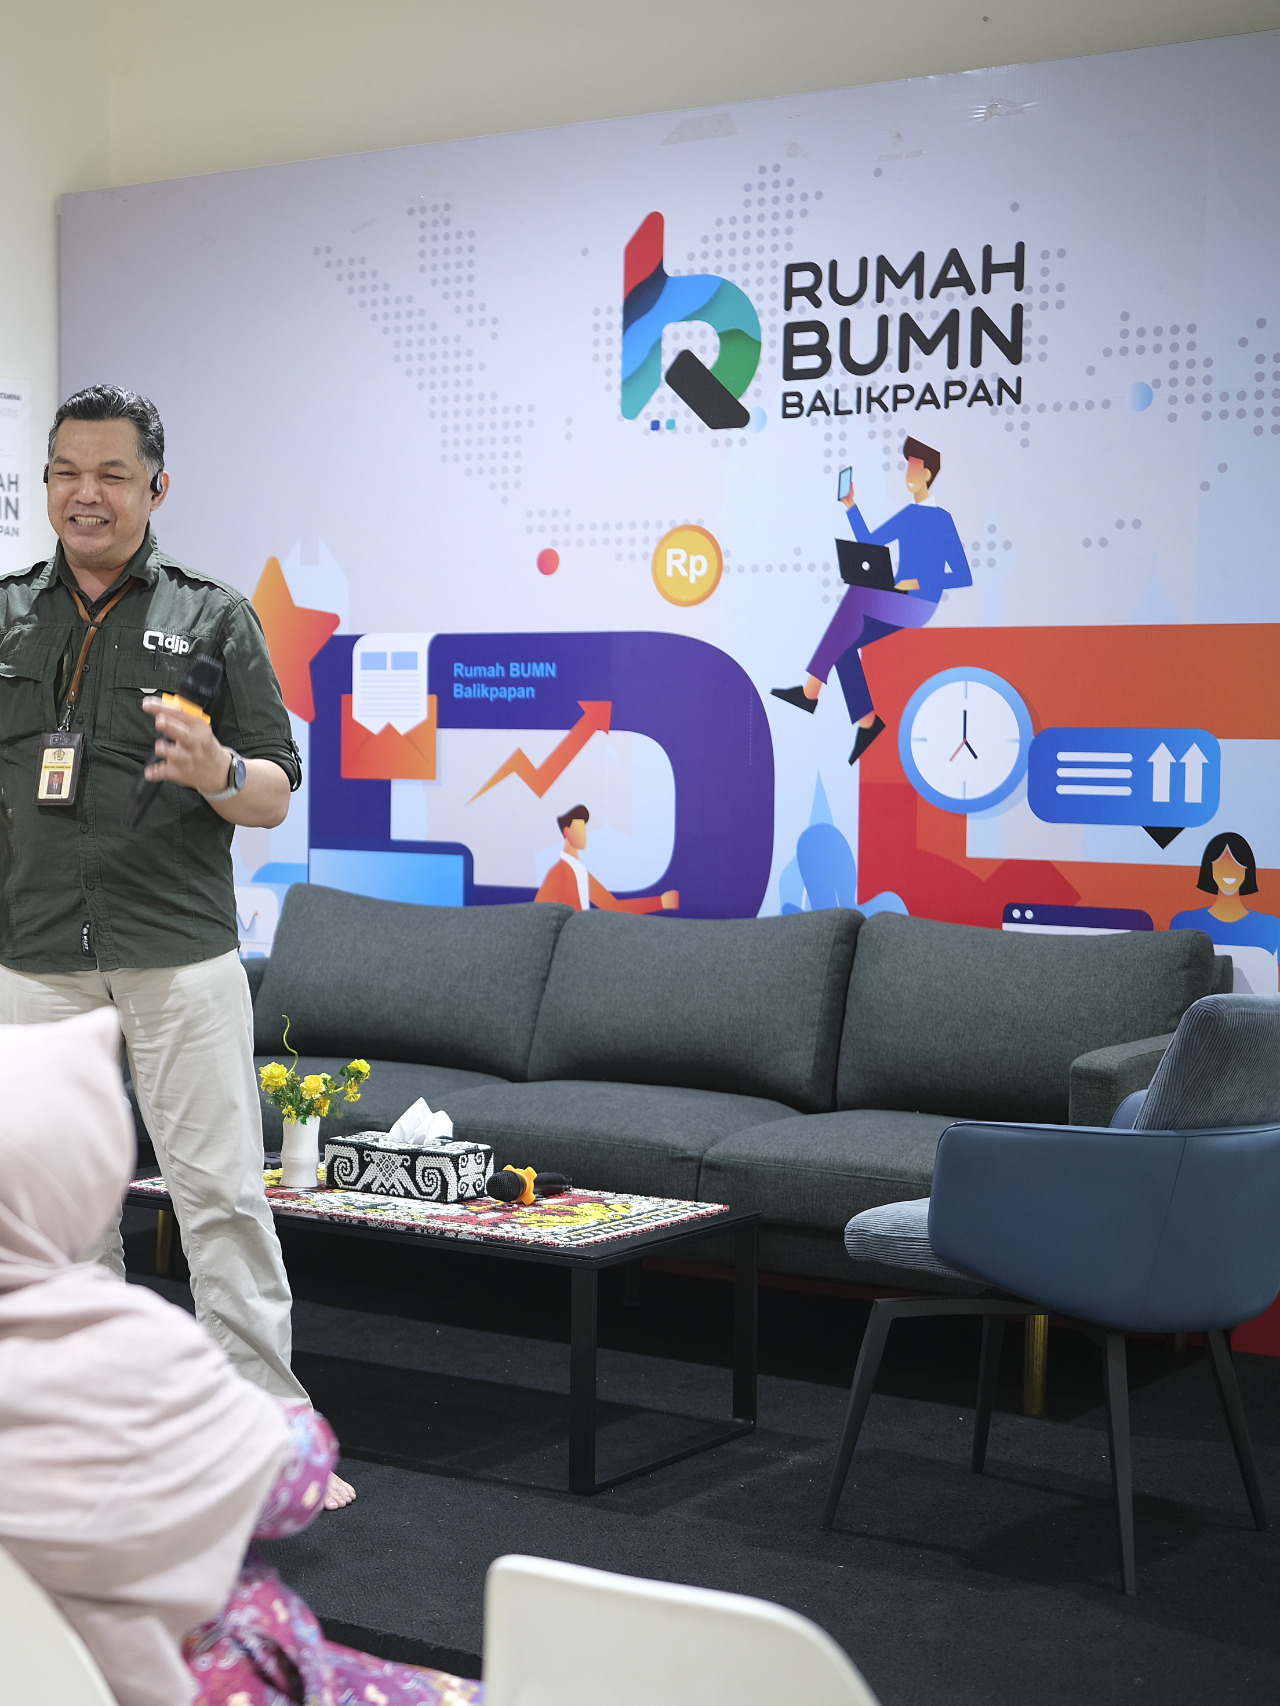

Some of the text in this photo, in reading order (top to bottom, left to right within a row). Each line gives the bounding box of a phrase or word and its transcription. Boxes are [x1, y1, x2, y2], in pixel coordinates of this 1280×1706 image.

[783, 241, 1025, 312] RUMAH
[782, 303, 1024, 381] BUMN
[781, 376, 1022, 419] BALIKPAPAN
[666, 548, 708, 584] Rp
[164, 634, 190, 655] djp
[453, 662, 557, 678] Rumah BUMN
[453, 683, 536, 702] Balikpapan
